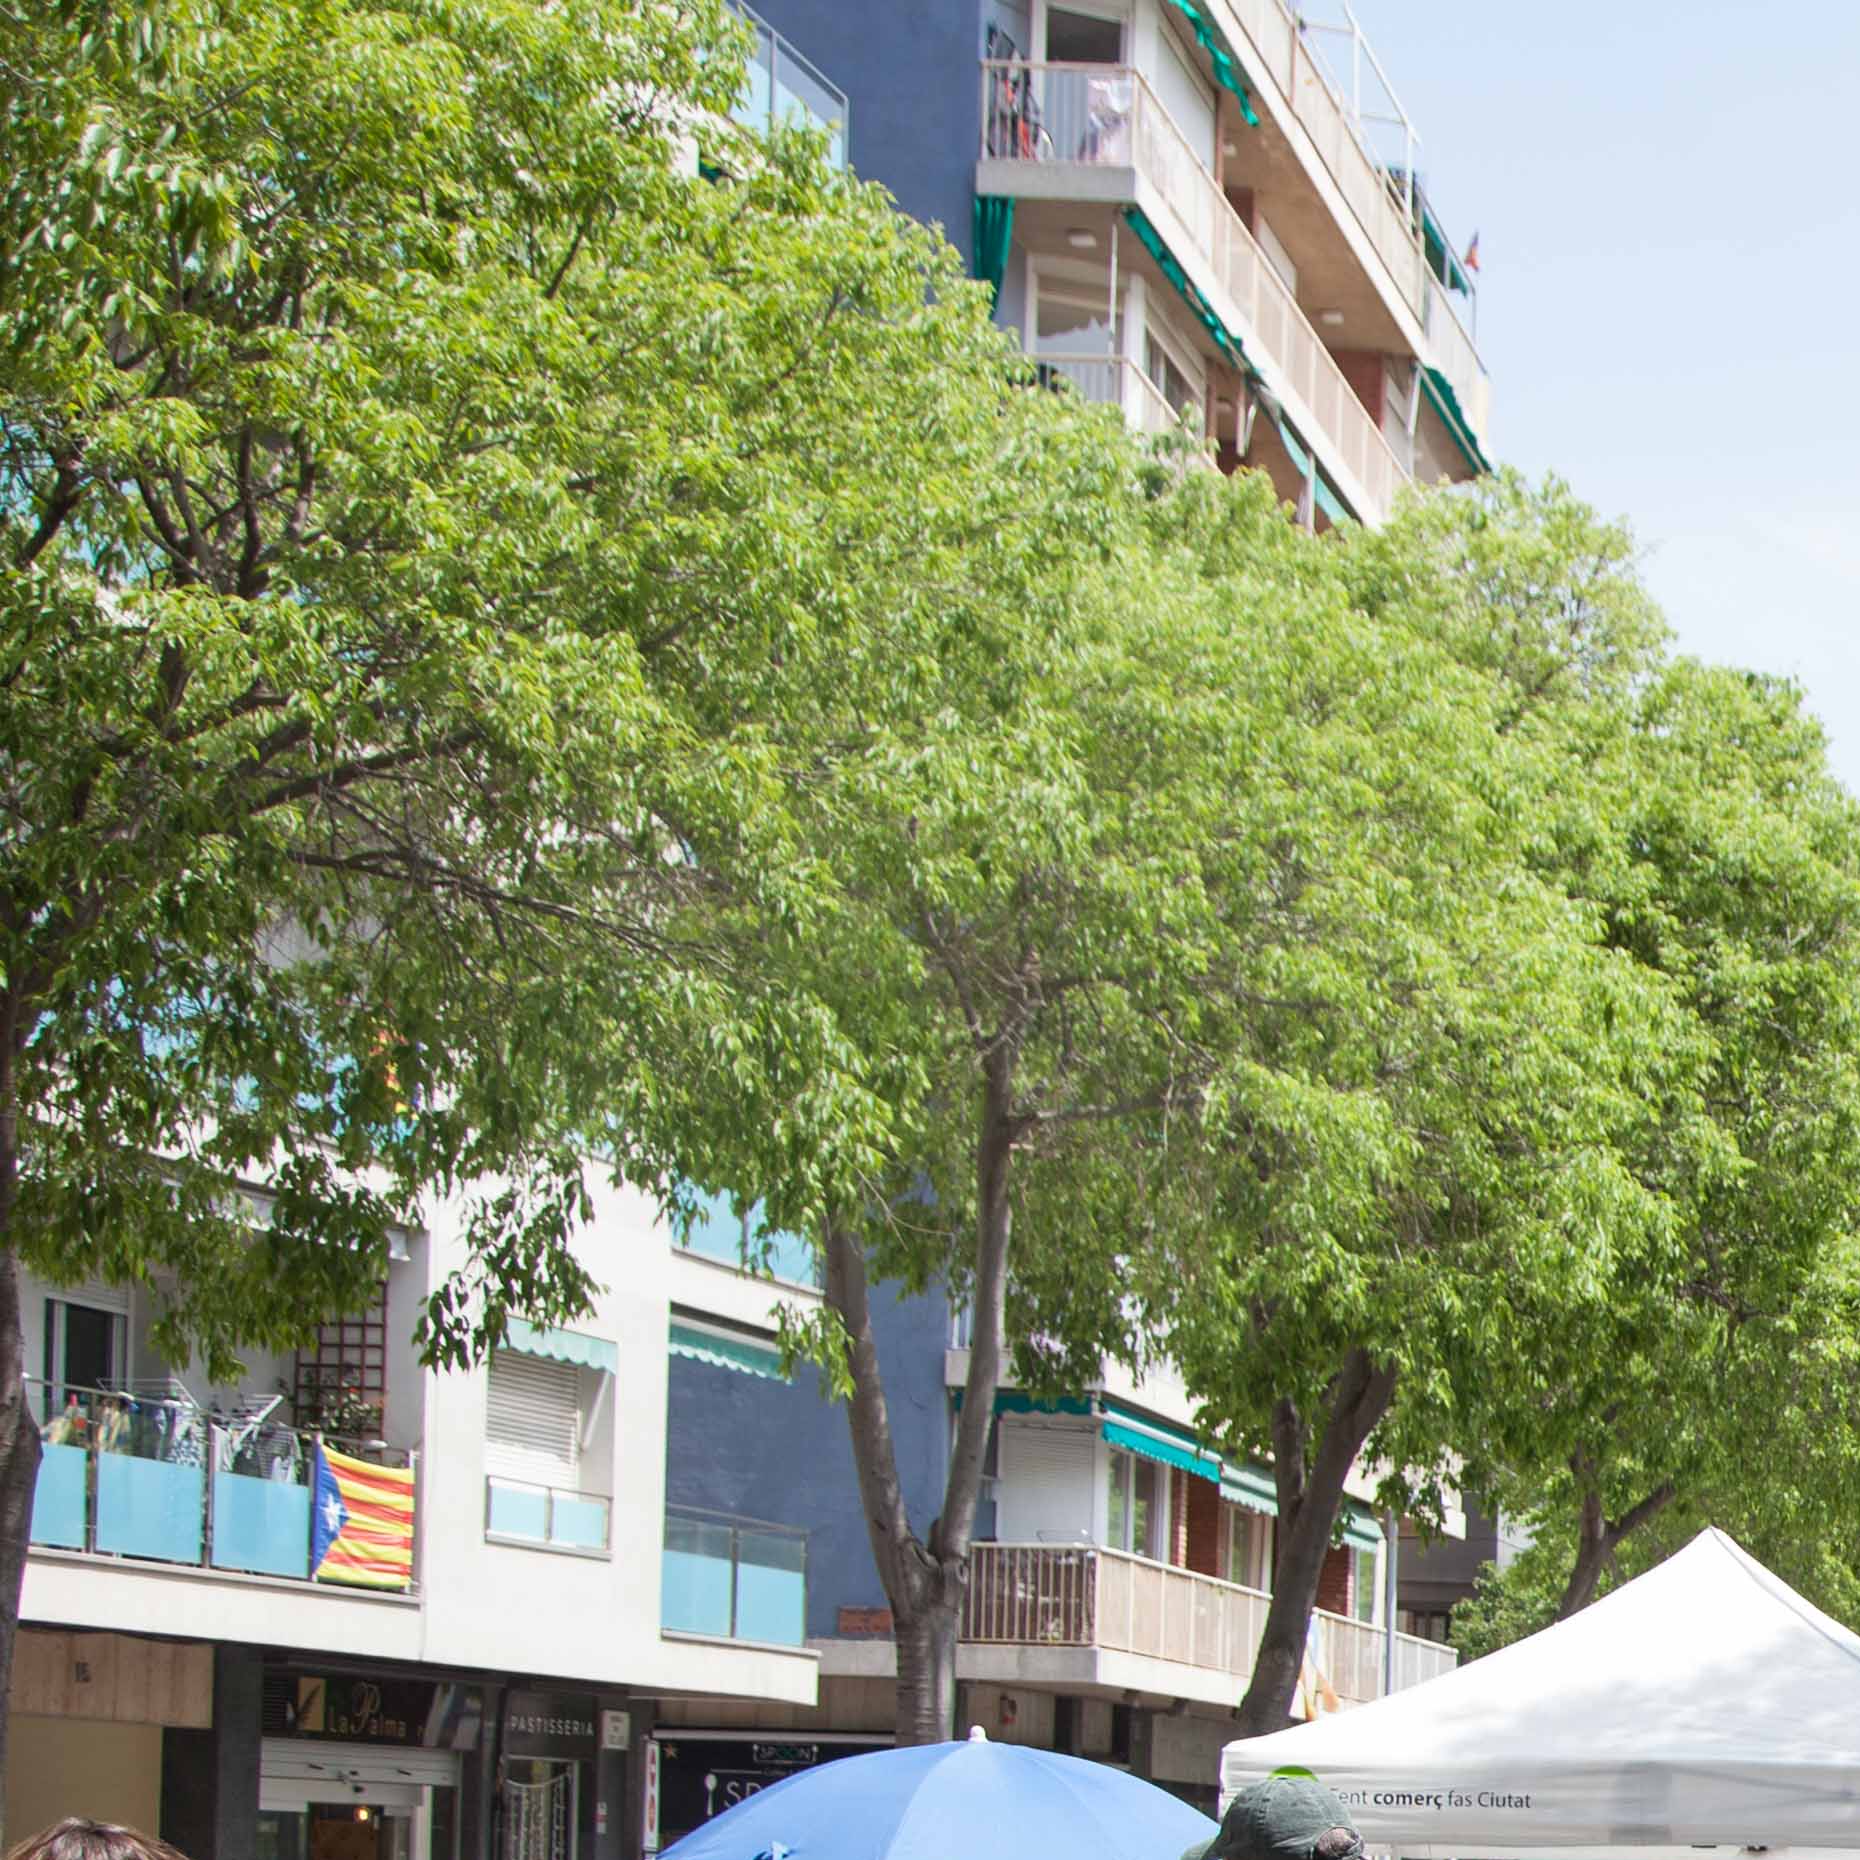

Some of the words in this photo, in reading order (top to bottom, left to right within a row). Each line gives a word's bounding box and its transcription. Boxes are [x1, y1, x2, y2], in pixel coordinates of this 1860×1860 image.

[511, 1715, 594, 1737] PASTISSERIA
[1330, 1787, 1368, 1805] ent
[1373, 1791, 1443, 1810] comerç
[1448, 1790, 1472, 1807] fas
[1478, 1791, 1531, 1808] Ciutat
